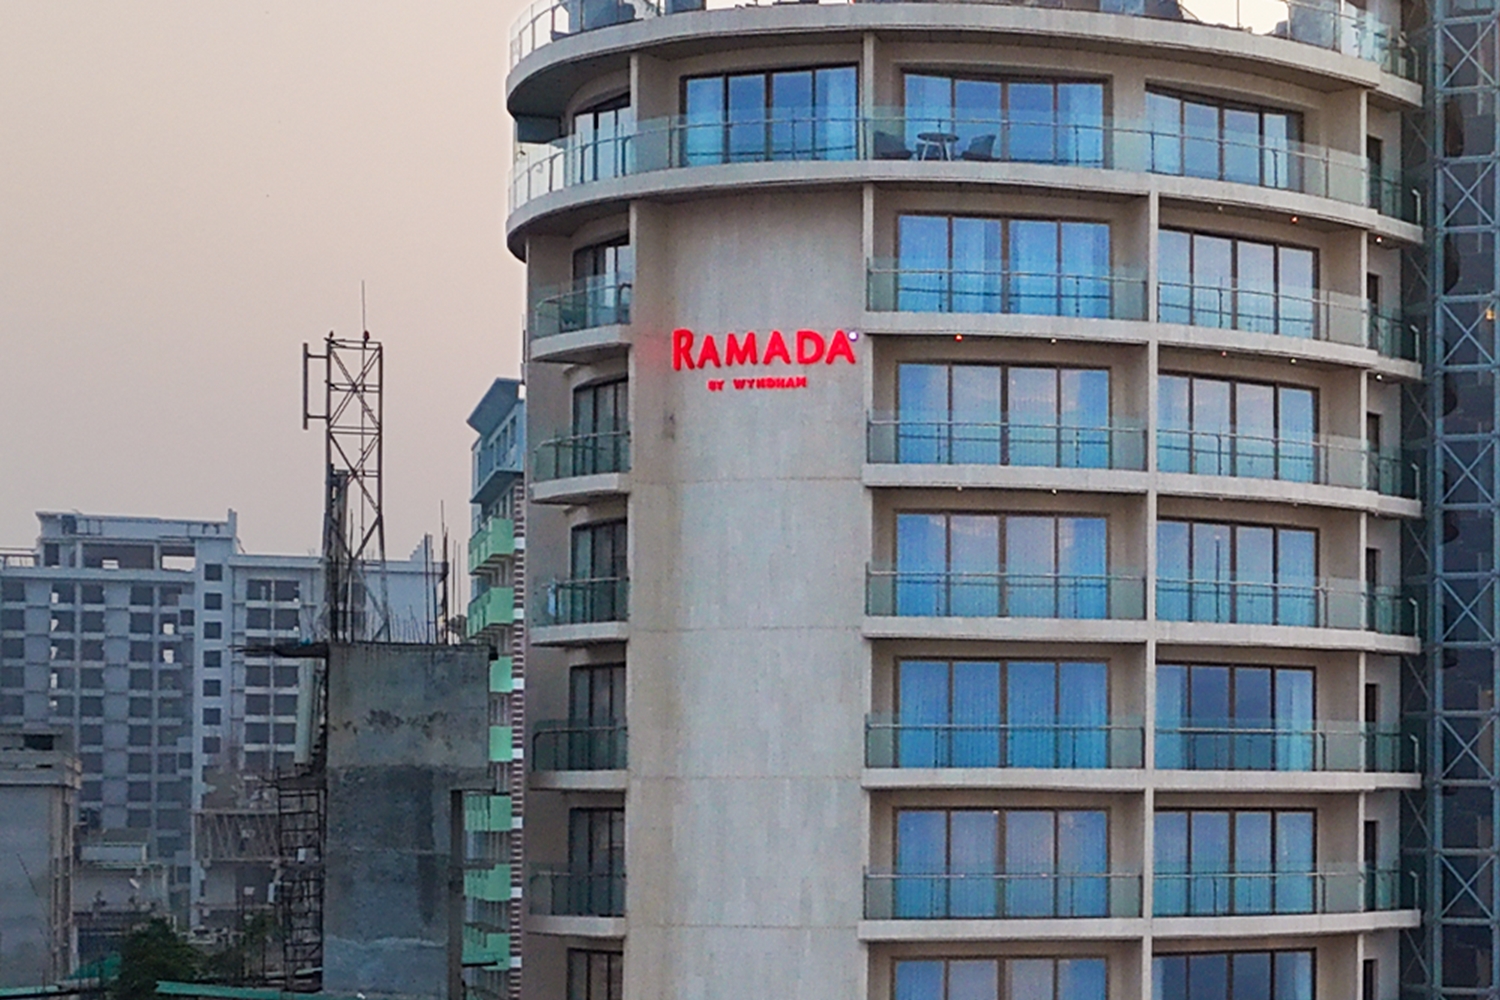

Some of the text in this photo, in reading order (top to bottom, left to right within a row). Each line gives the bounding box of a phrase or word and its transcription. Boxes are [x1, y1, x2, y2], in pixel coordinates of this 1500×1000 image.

[672, 329, 855, 371] RAMADA
[707, 376, 807, 391] BY WYNDHAM
